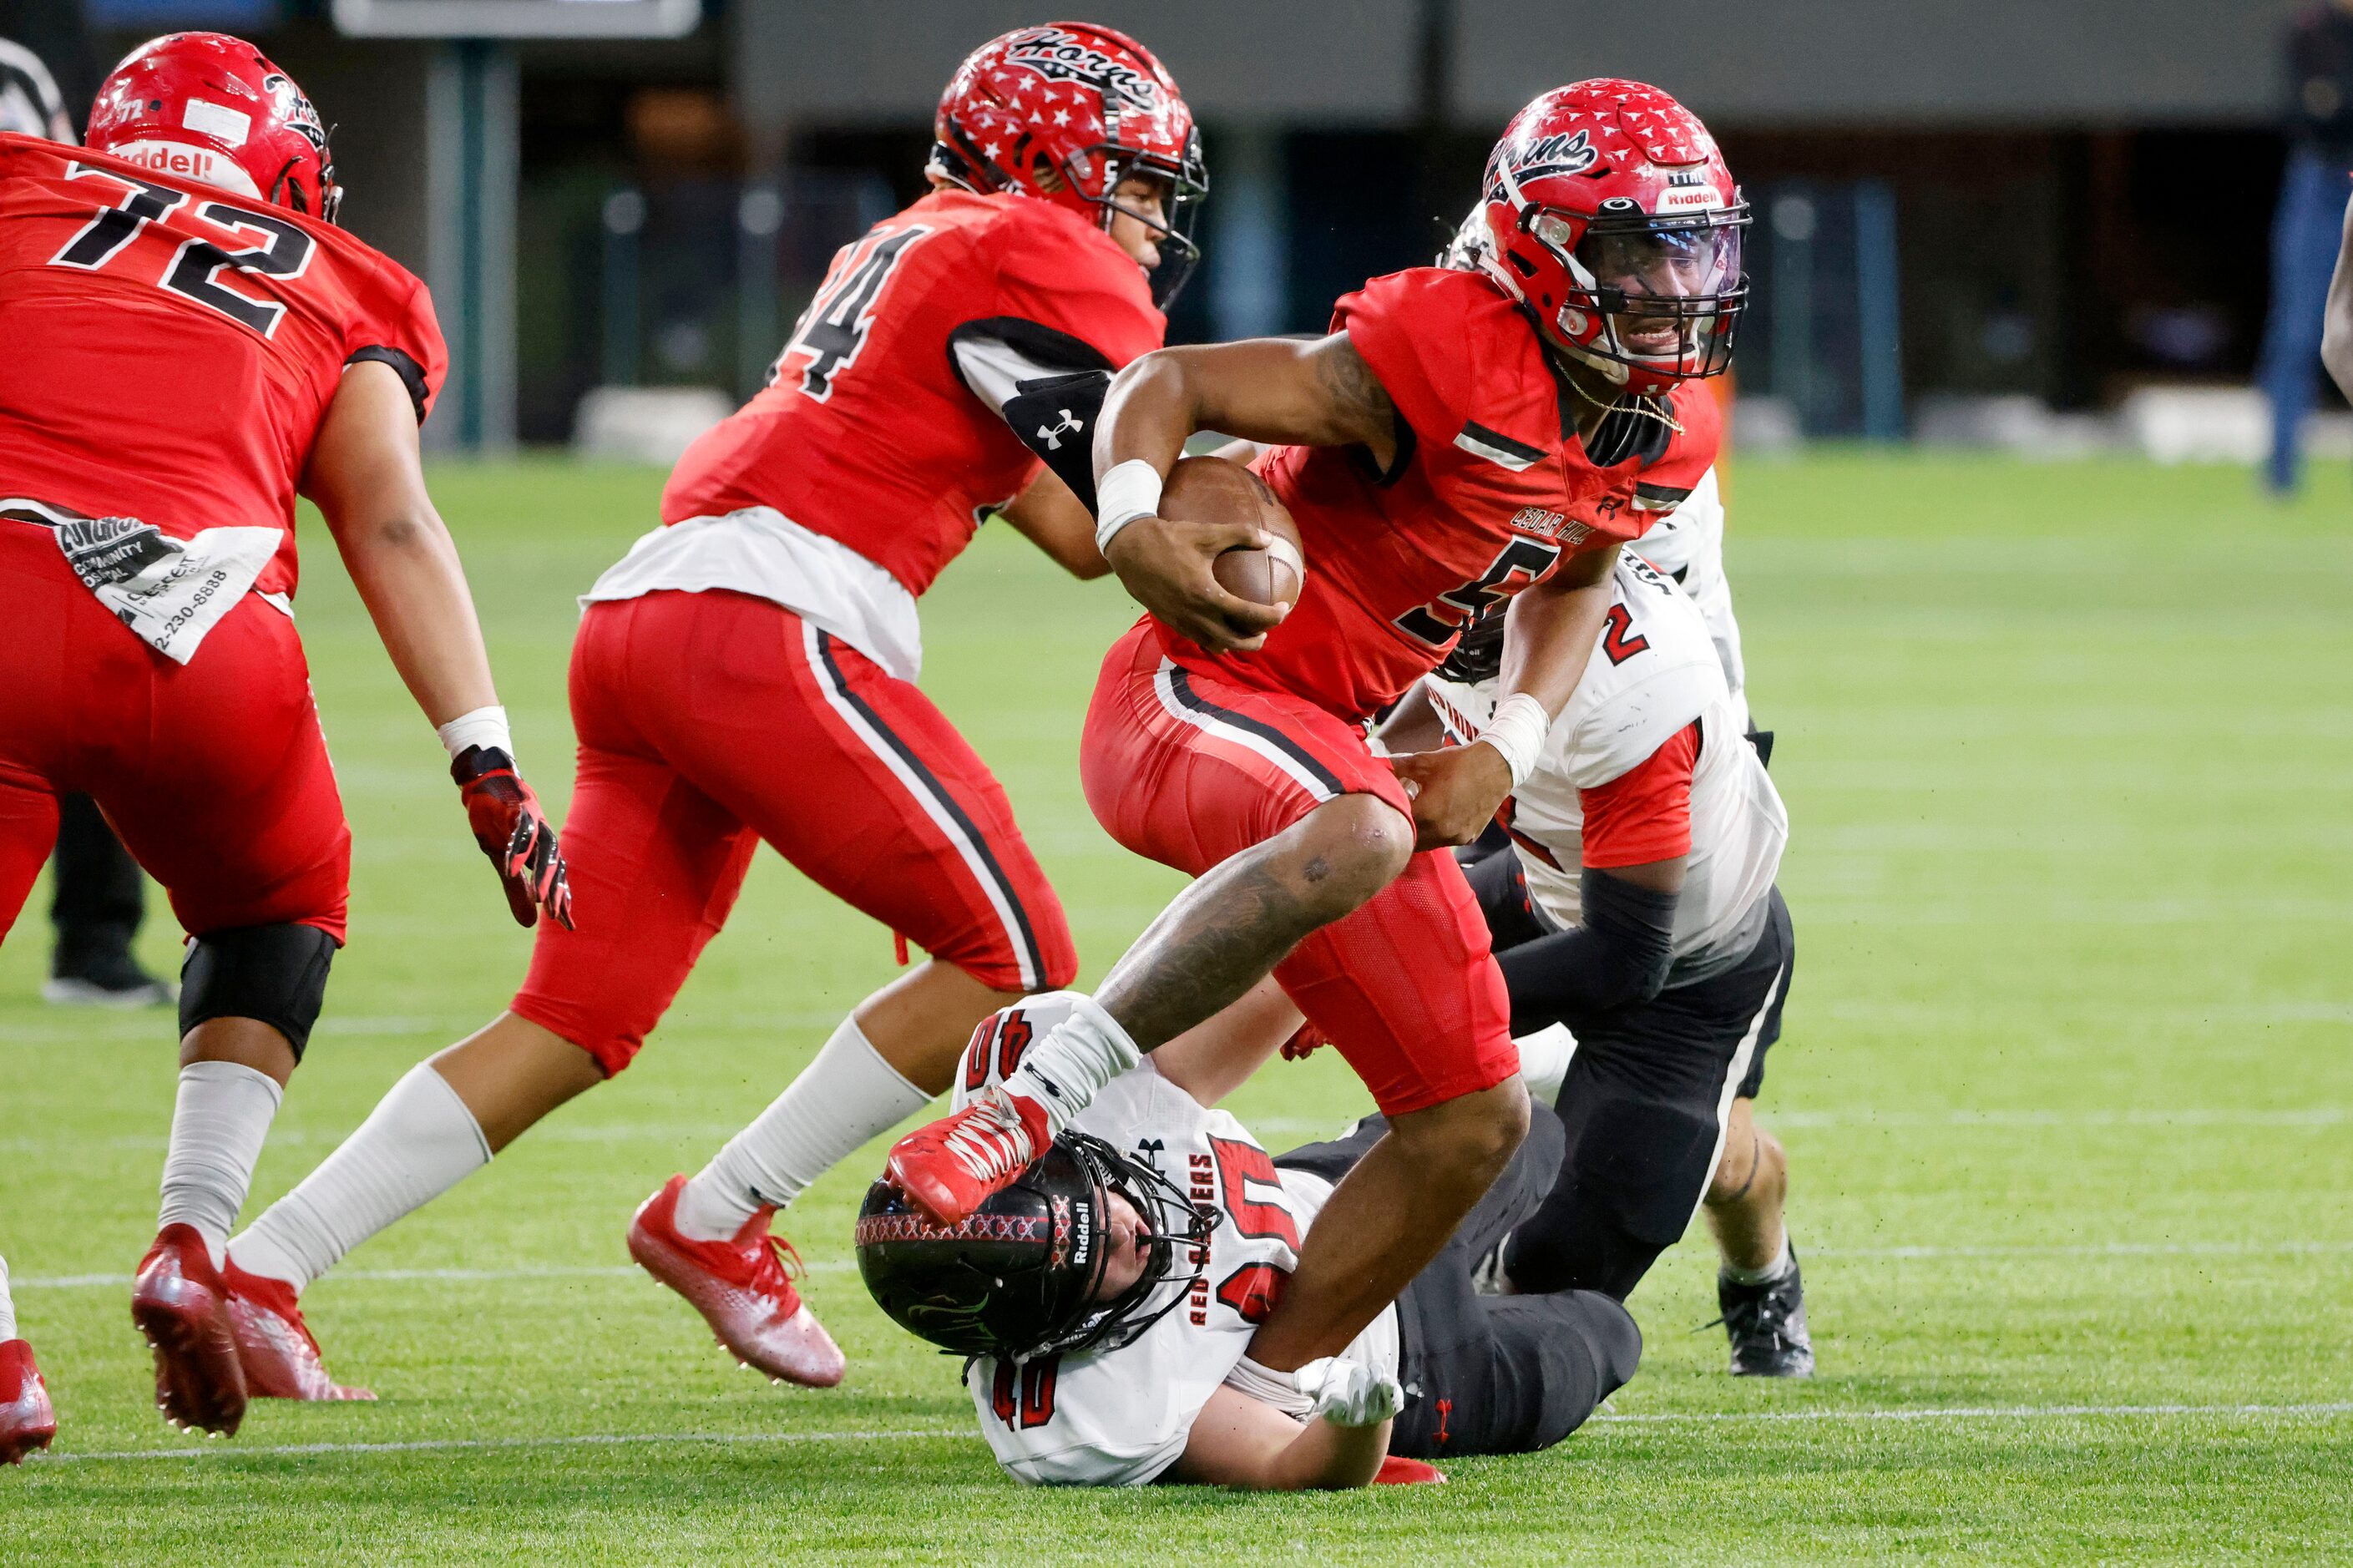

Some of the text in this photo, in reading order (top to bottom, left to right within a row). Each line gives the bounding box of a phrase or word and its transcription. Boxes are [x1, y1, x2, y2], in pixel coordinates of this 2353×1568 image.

[998, 27, 1157, 114] Horns
[1667, 192, 1718, 205] Riddell
[48, 160, 316, 341] 72
[1510, 506, 1565, 538] CEDAR
[1390, 534, 1561, 648] 5
[1602, 602, 1651, 667] 2
[1074, 1202, 1090, 1264] Riddell
[1189, 1278, 1210, 1326] RED
